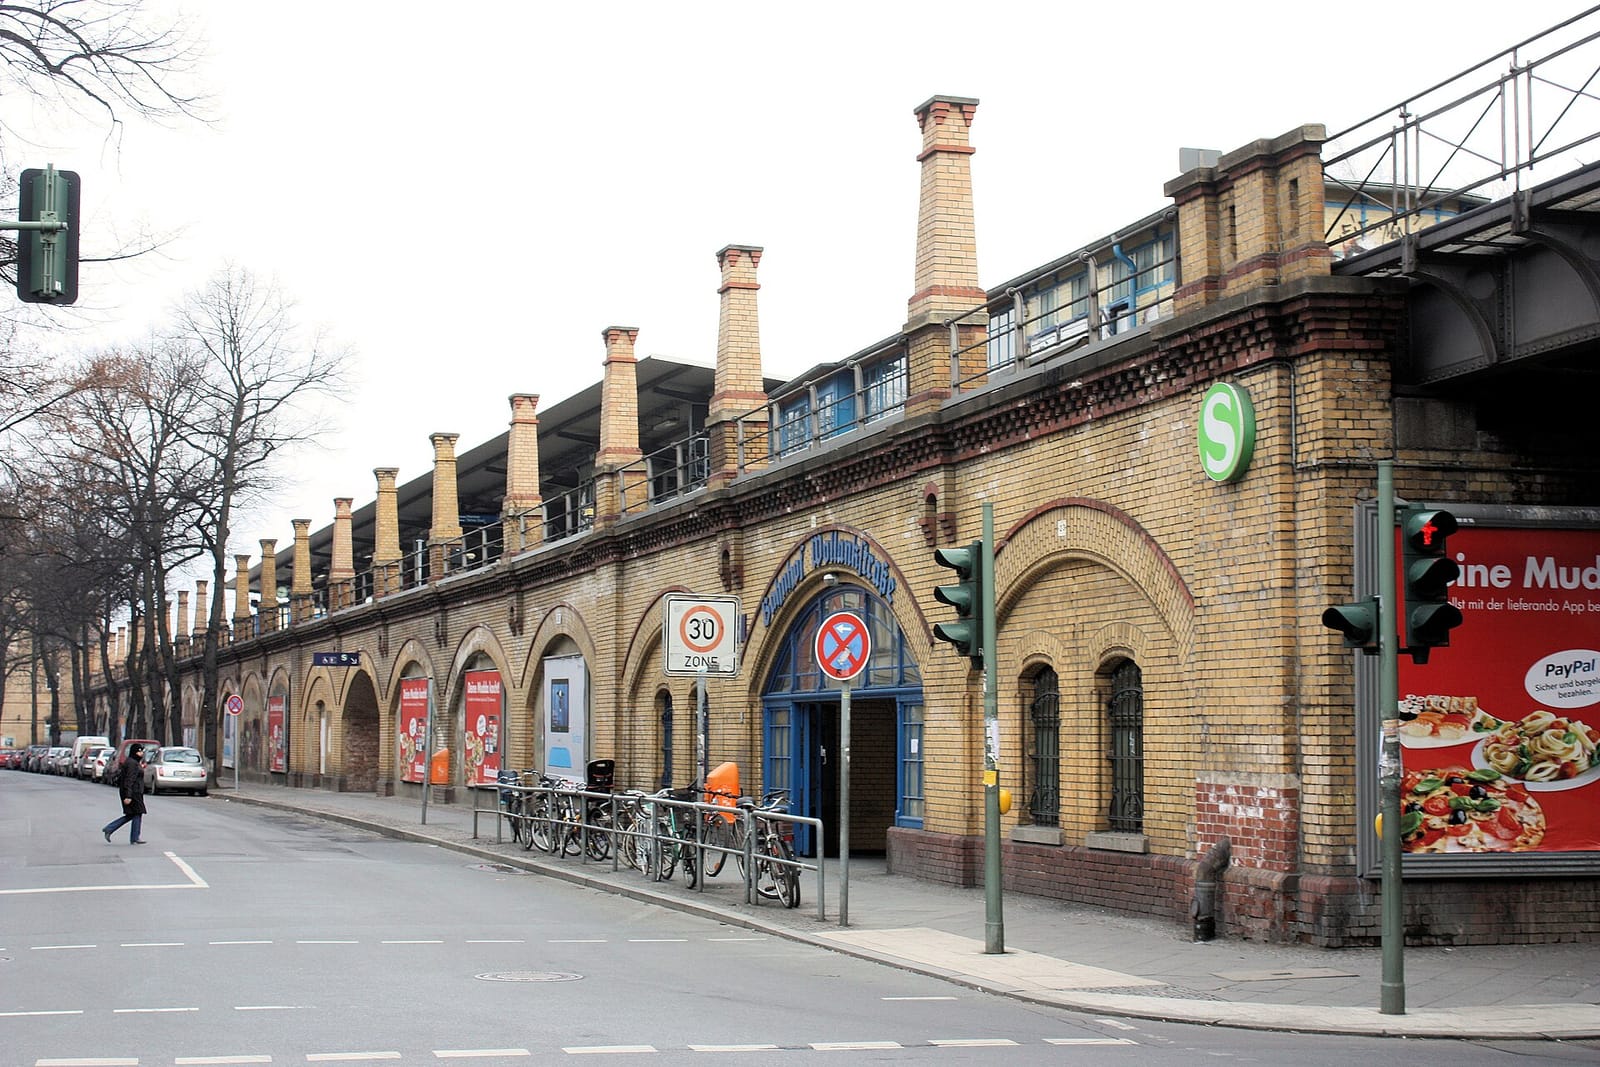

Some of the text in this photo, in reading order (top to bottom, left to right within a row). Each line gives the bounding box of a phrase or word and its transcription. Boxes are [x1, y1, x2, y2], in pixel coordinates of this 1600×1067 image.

[1204, 392, 1235, 473] S
[1447, 552, 1512, 589] ine
[1468, 598, 1484, 610] mit
[1487, 597, 1505, 610] der
[1507, 597, 1560, 612] lieferando
[1562, 599, 1585, 615] App
[689, 618, 715, 640] 30
[1545, 658, 1596, 678] PayPal
[1535, 682, 1557, 692] Sicher
[1559, 680, 1573, 689] und
